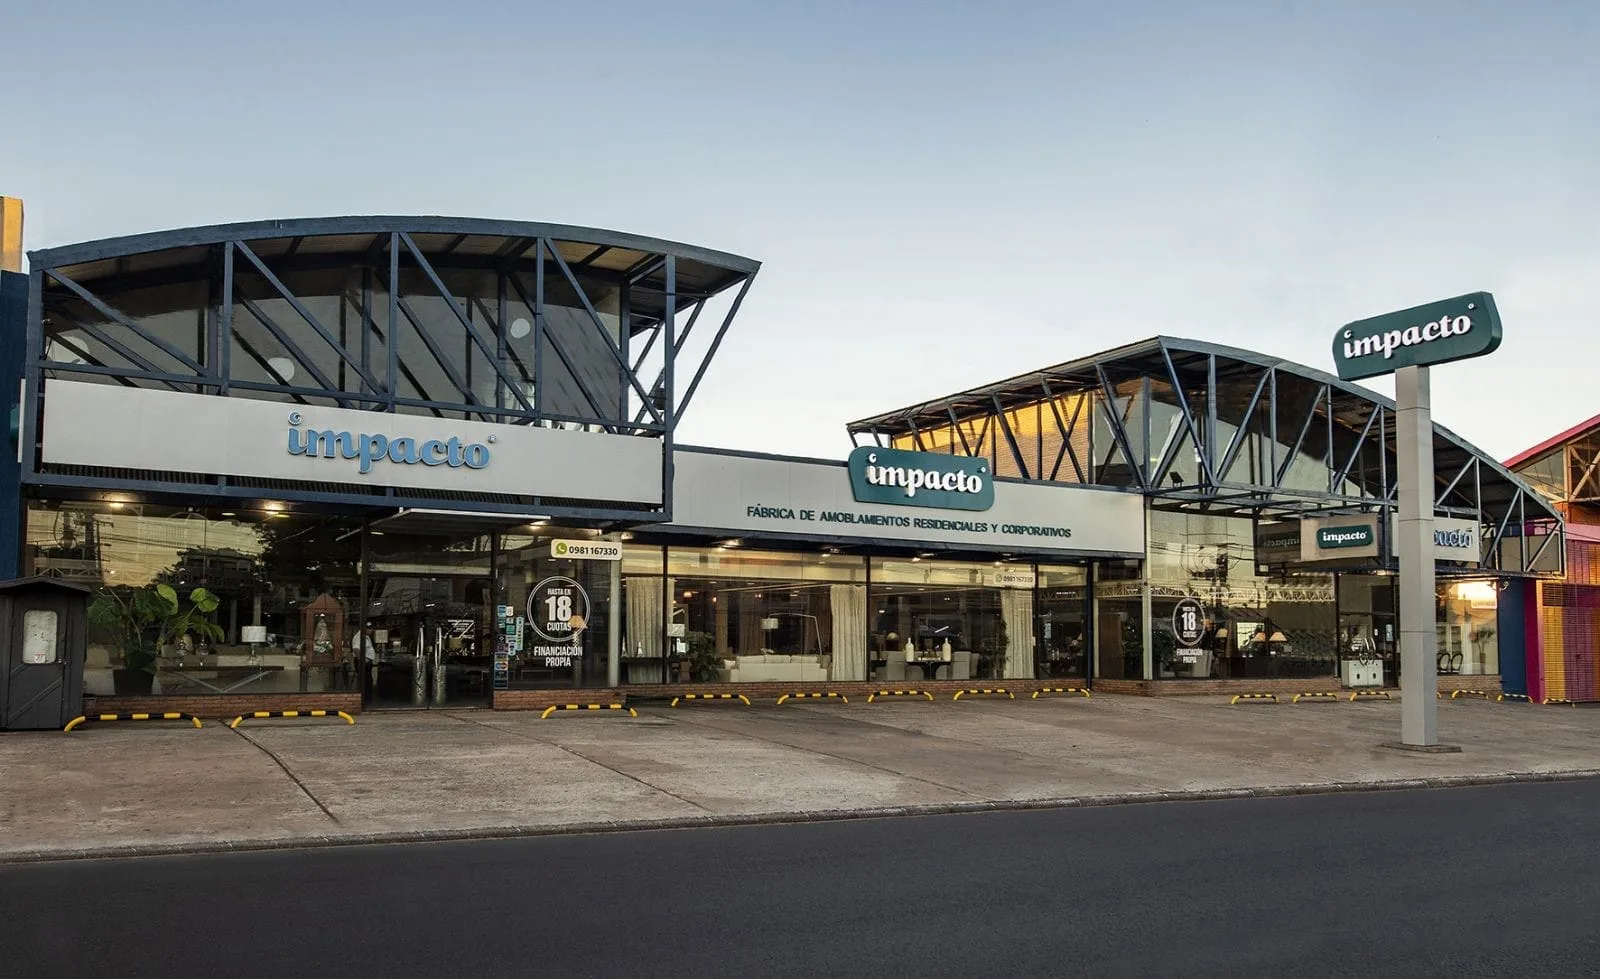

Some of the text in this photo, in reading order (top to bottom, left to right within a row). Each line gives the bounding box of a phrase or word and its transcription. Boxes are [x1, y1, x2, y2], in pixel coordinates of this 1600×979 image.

[1343, 313, 1472, 359] impacto
[288, 411, 490, 474] impacto
[867, 453, 983, 497] impacto
[747, 503, 1072, 538] FÁBRICA DE AMOBLAMIENTOS RESIDENCIALES Y CORPORATIVOS
[1322, 531, 1367, 544] impacto
[545, 595, 572, 622] 18
[546, 622, 572, 631] CUOTAS
[1181, 611, 1196, 631] 18
[534, 645, 583, 657] FINANCIACIÓN
[545, 656, 572, 667] PROPIA
